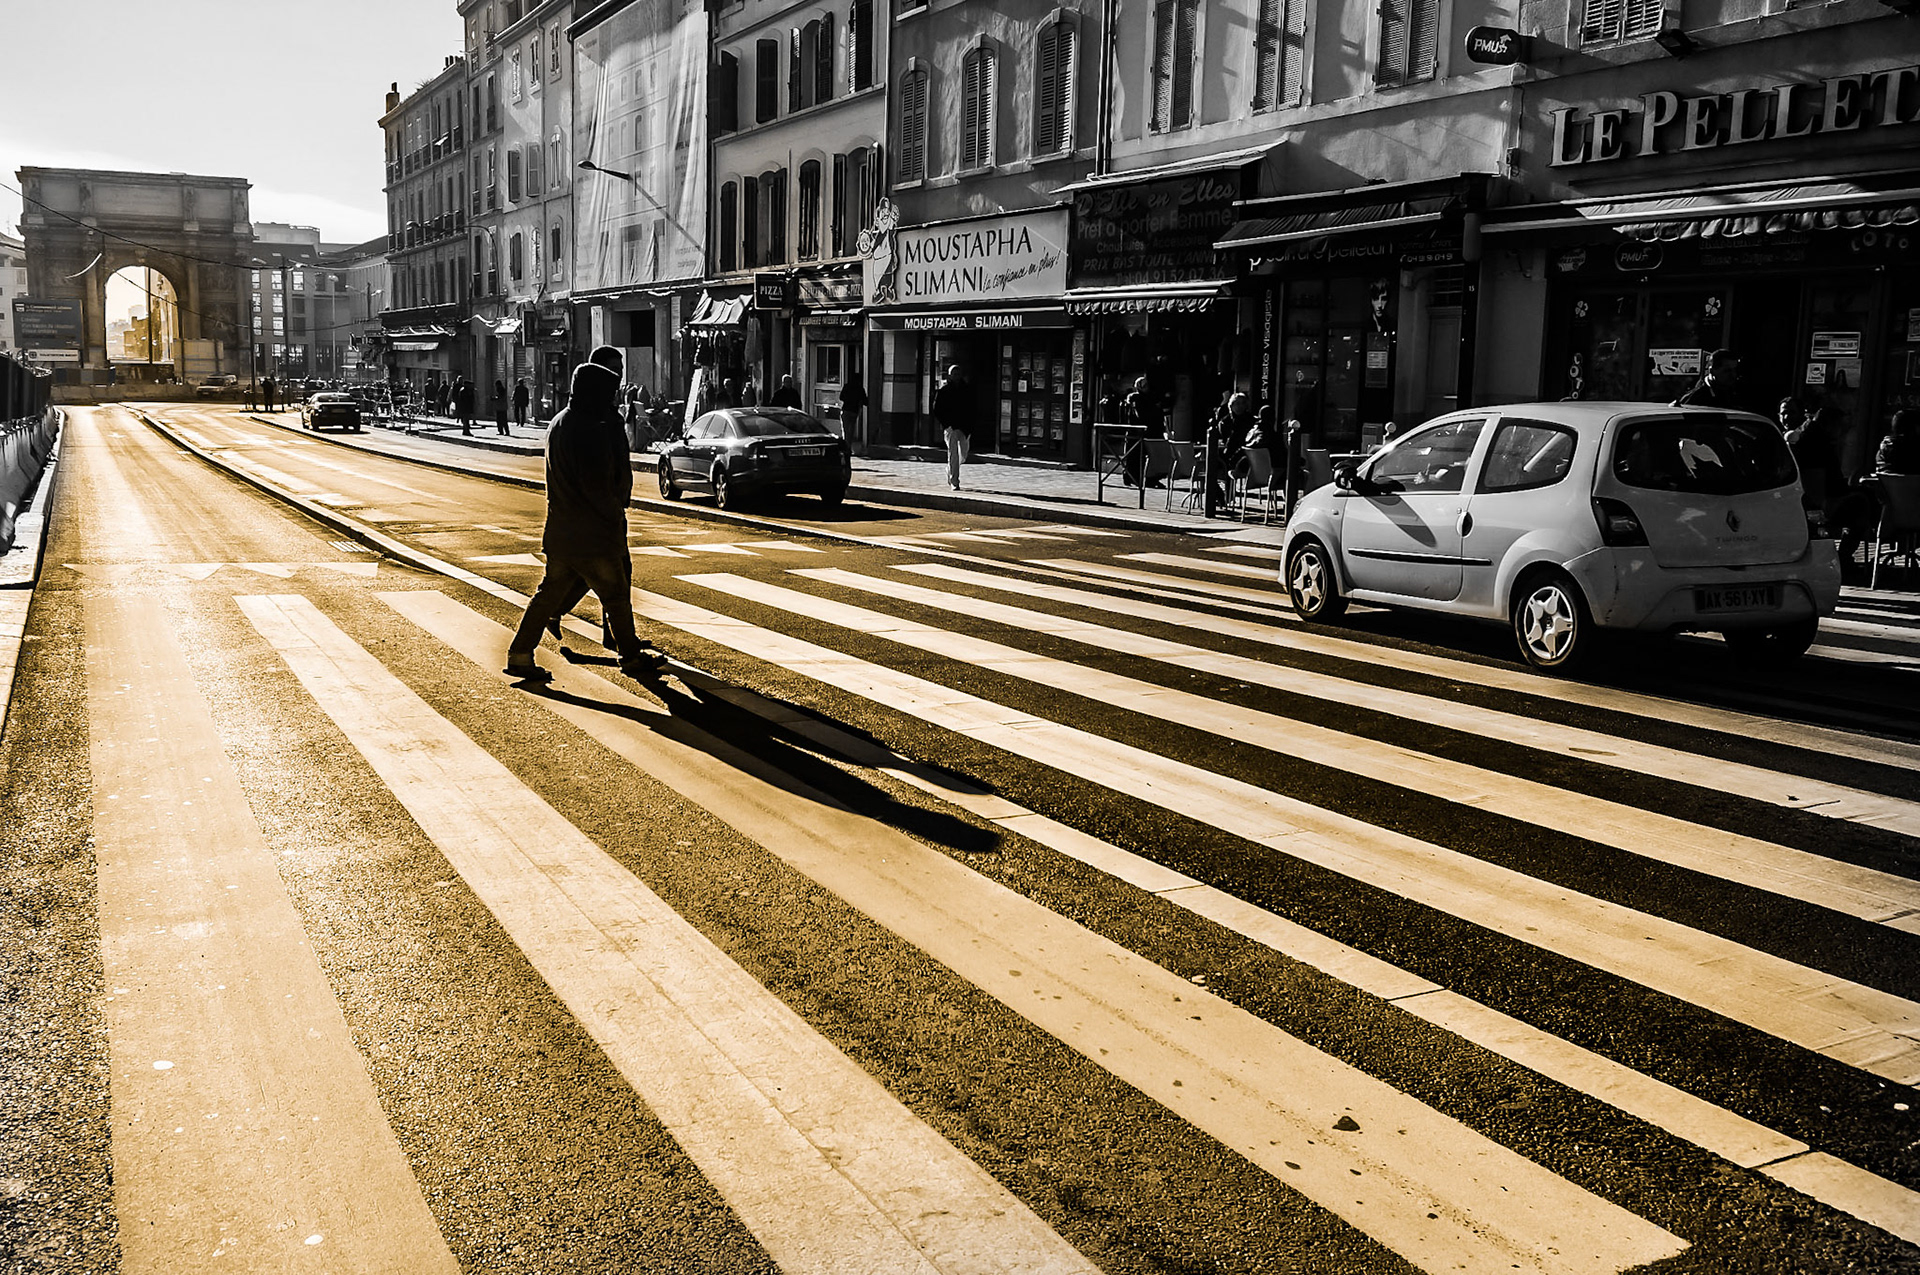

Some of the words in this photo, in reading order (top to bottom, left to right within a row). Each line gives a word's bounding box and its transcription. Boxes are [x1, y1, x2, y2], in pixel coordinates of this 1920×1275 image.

[1474, 38, 1500, 53] PMU
[1549, 107, 1624, 167] LE
[1636, 66, 1920, 157] PELLET
[1147, 192, 1170, 209] en
[1178, 176, 1236, 206] Elles
[1122, 212, 1164, 236] porter
[1169, 206, 1232, 230] Femme
[905, 225, 1033, 266] MOUSTAPHA
[1852, 231, 1910, 252] LOTO
[1083, 256, 1109, 271] PRIX
[1139, 251, 1176, 268] TOUTE
[760, 285, 784, 297] PIZZA
[905, 266, 983, 297] SLIMANI
[904, 316, 968, 330] MOUSTAPHA
[974, 314, 1023, 328] SLIMANI
[1715, 535, 1758, 543] TWINGO
